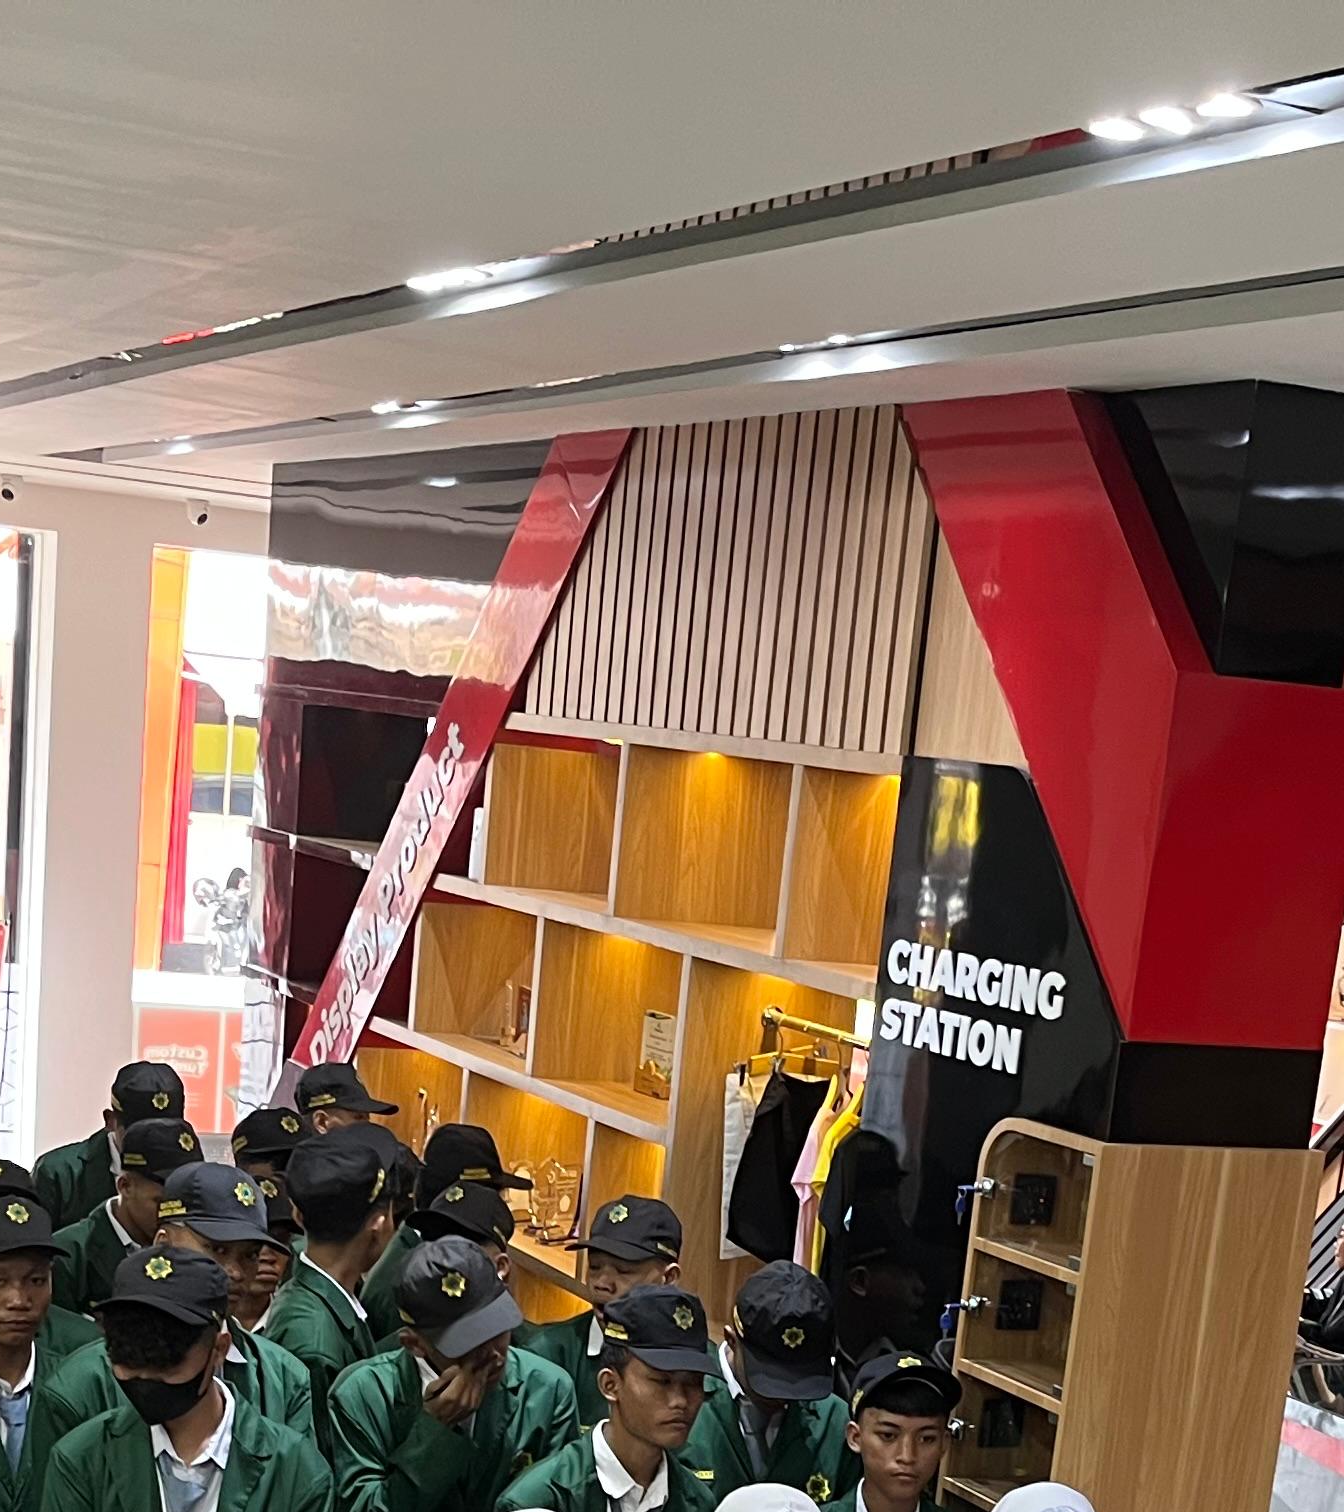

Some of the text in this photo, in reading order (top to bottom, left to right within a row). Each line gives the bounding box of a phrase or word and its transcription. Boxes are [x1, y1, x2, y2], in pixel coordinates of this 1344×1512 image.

[309, 913, 380, 1068] Display
[887, 938, 1067, 1021] CHARGING
[879, 997, 1023, 1075] STATION
